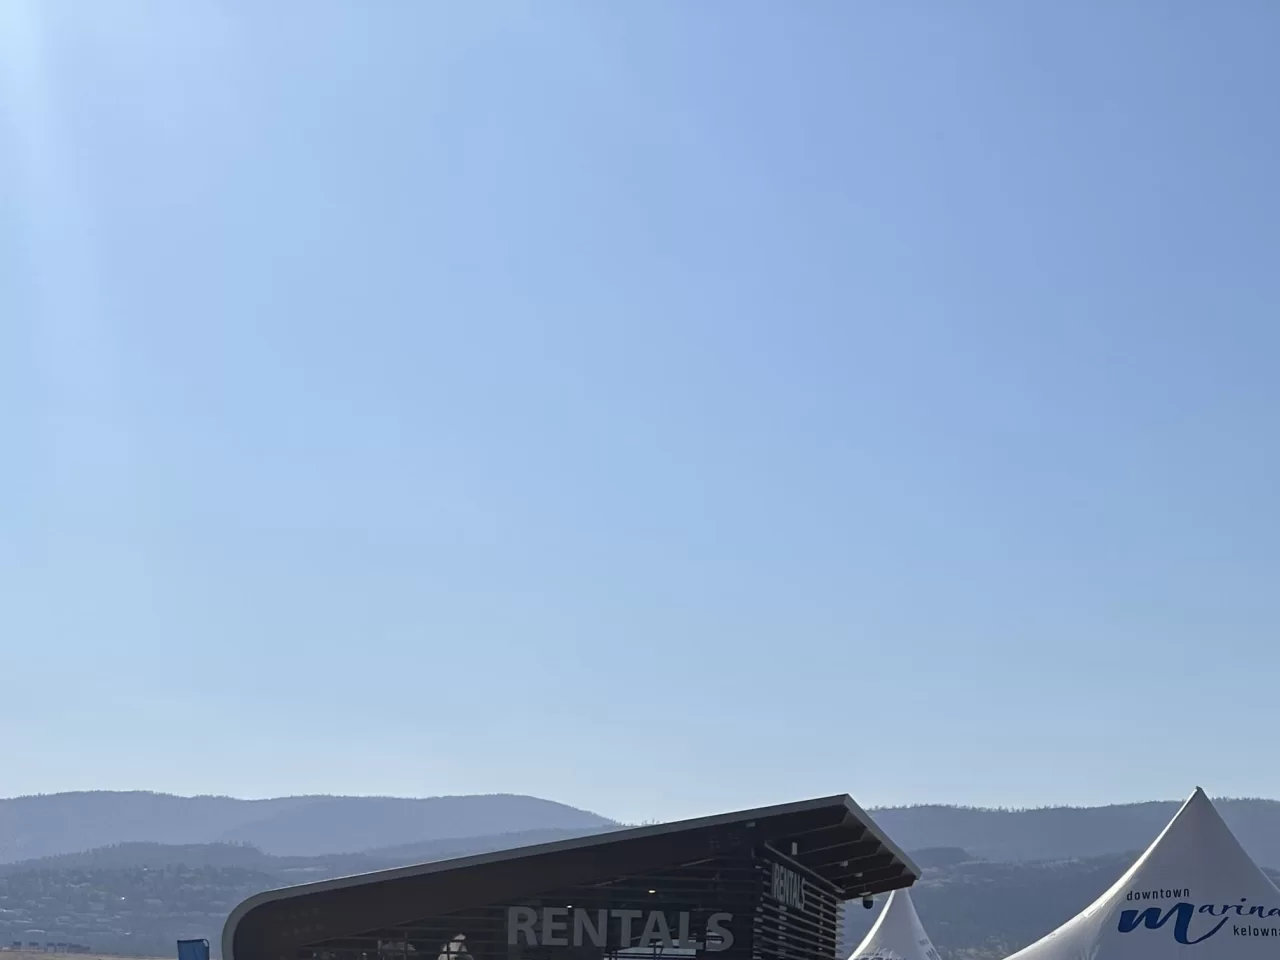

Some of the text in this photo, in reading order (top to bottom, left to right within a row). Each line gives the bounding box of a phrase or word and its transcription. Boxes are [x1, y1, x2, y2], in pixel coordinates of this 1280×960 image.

[771, 863, 807, 911] RENTALS
[1126, 887, 1190, 901] downtown
[507, 906, 735, 951] RENTALS
